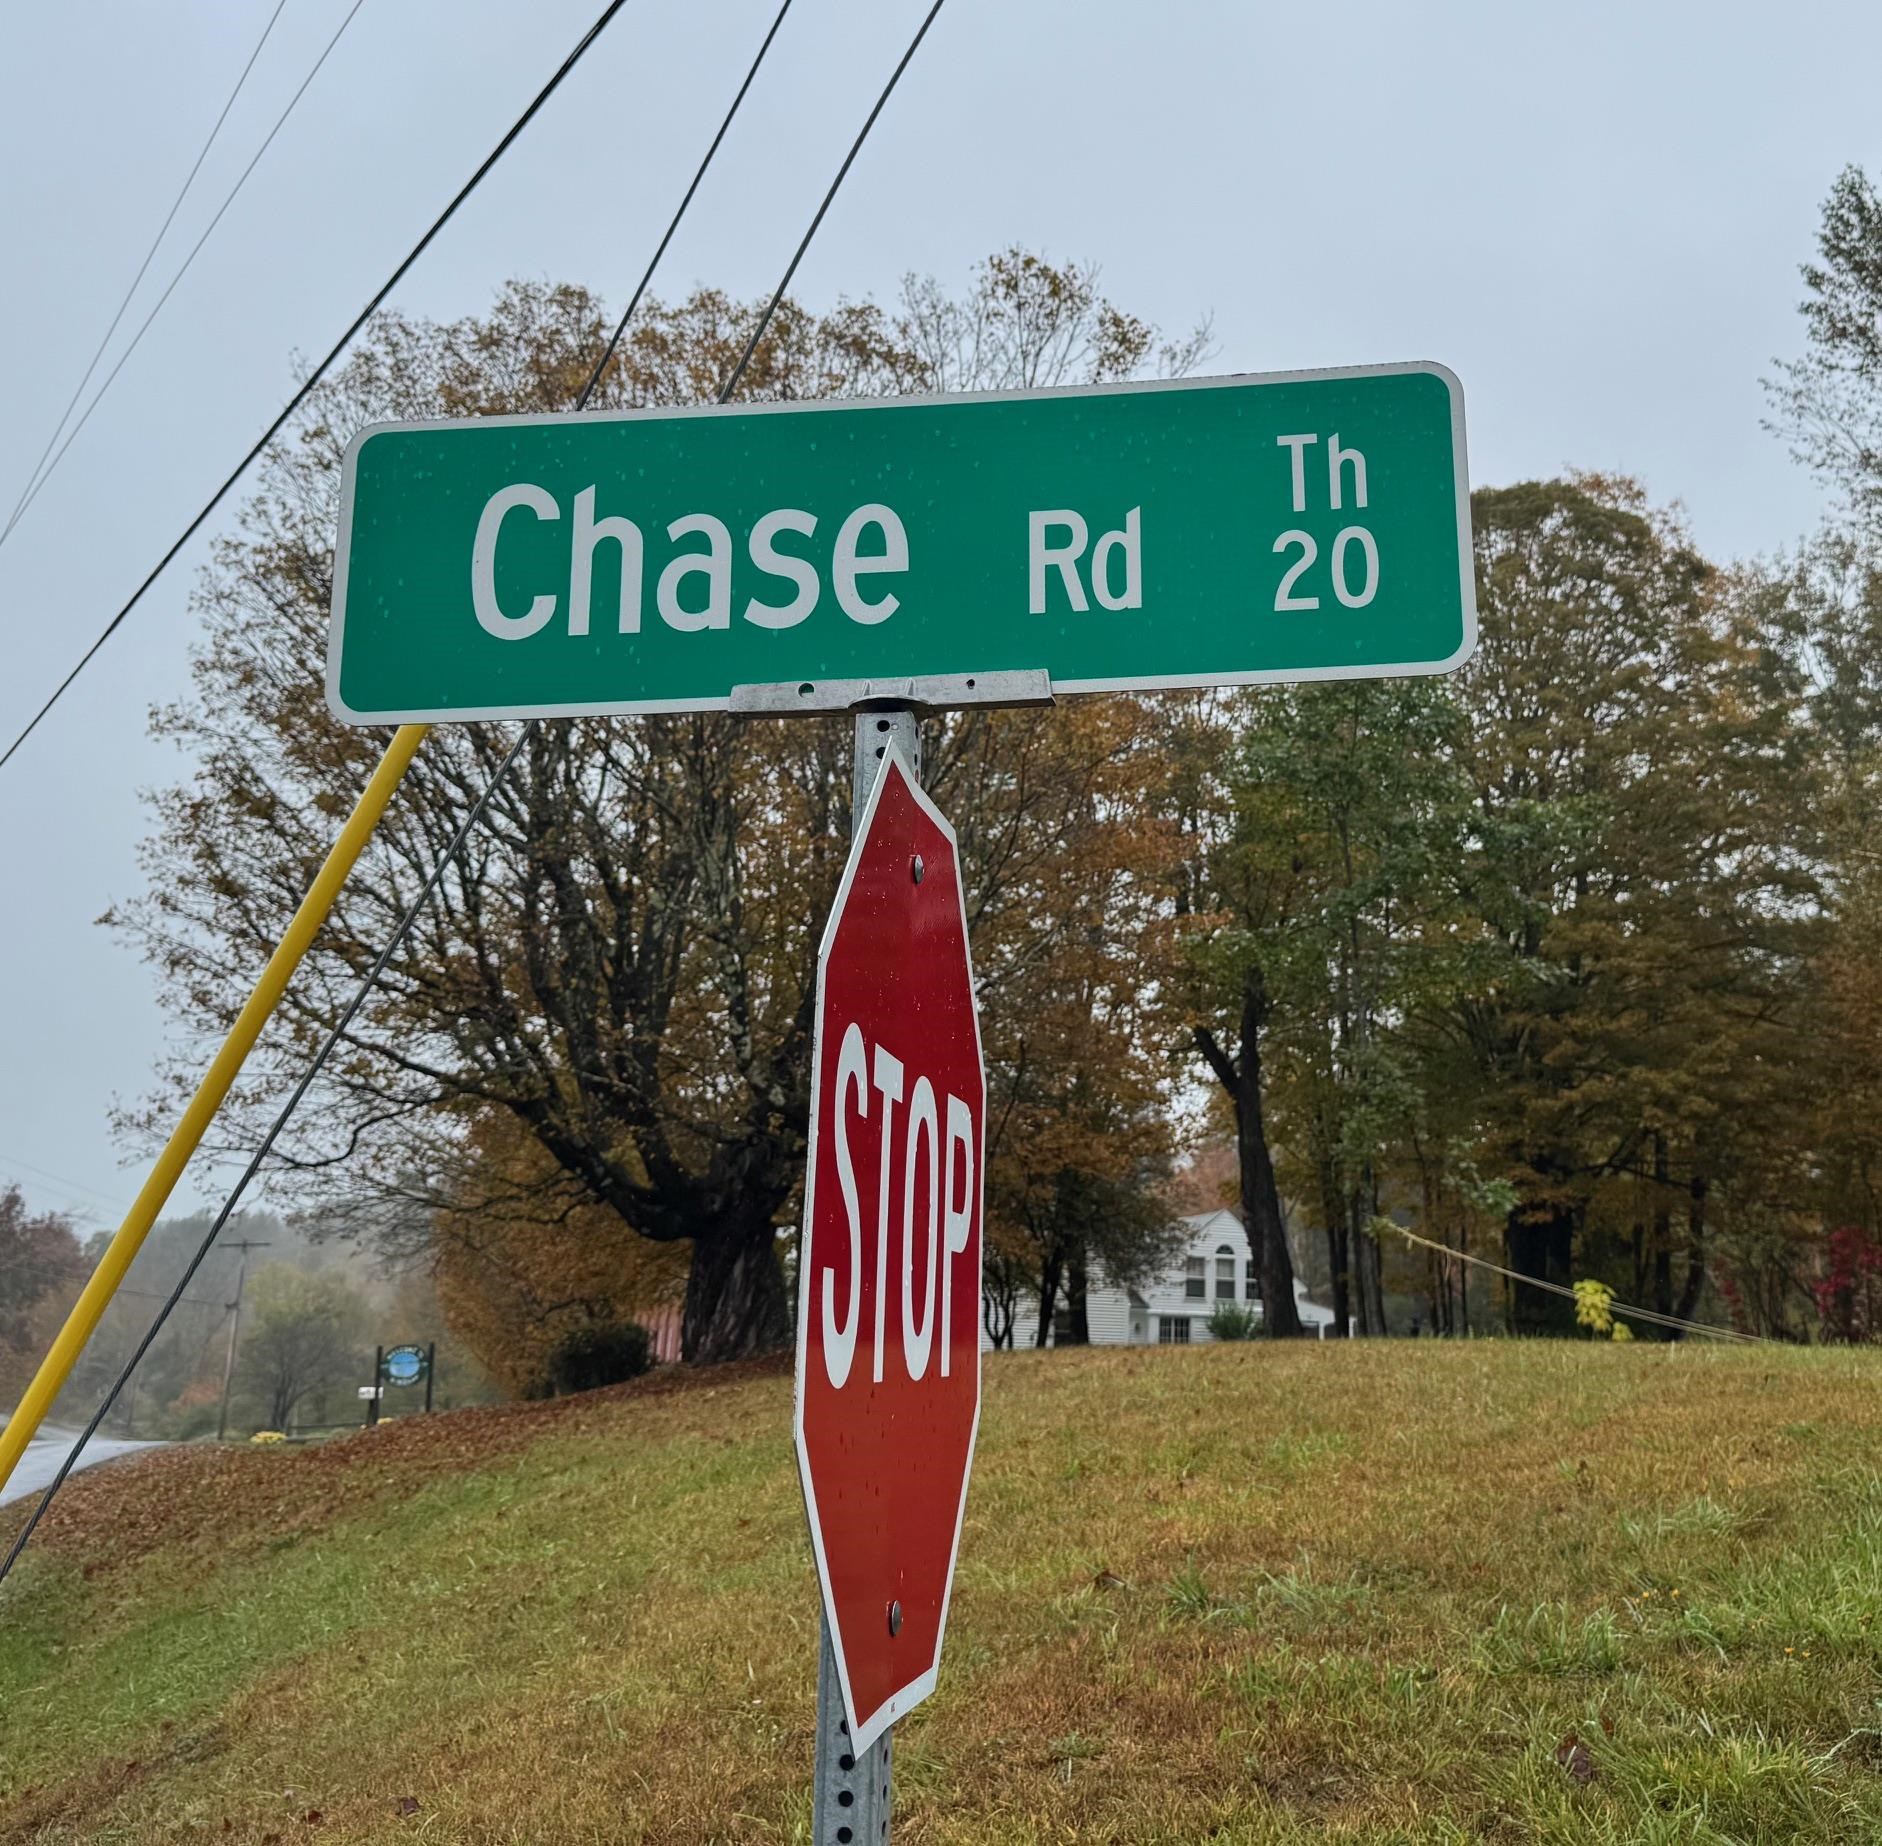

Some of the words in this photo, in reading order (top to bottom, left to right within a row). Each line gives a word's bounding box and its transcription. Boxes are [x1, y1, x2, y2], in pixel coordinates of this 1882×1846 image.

[1276, 433, 1368, 512] Th
[472, 483, 909, 641] Chase
[1029, 506, 1142, 614] Rd
[1273, 526, 1379, 612] 20
[822, 1022, 975, 1390] STOP
